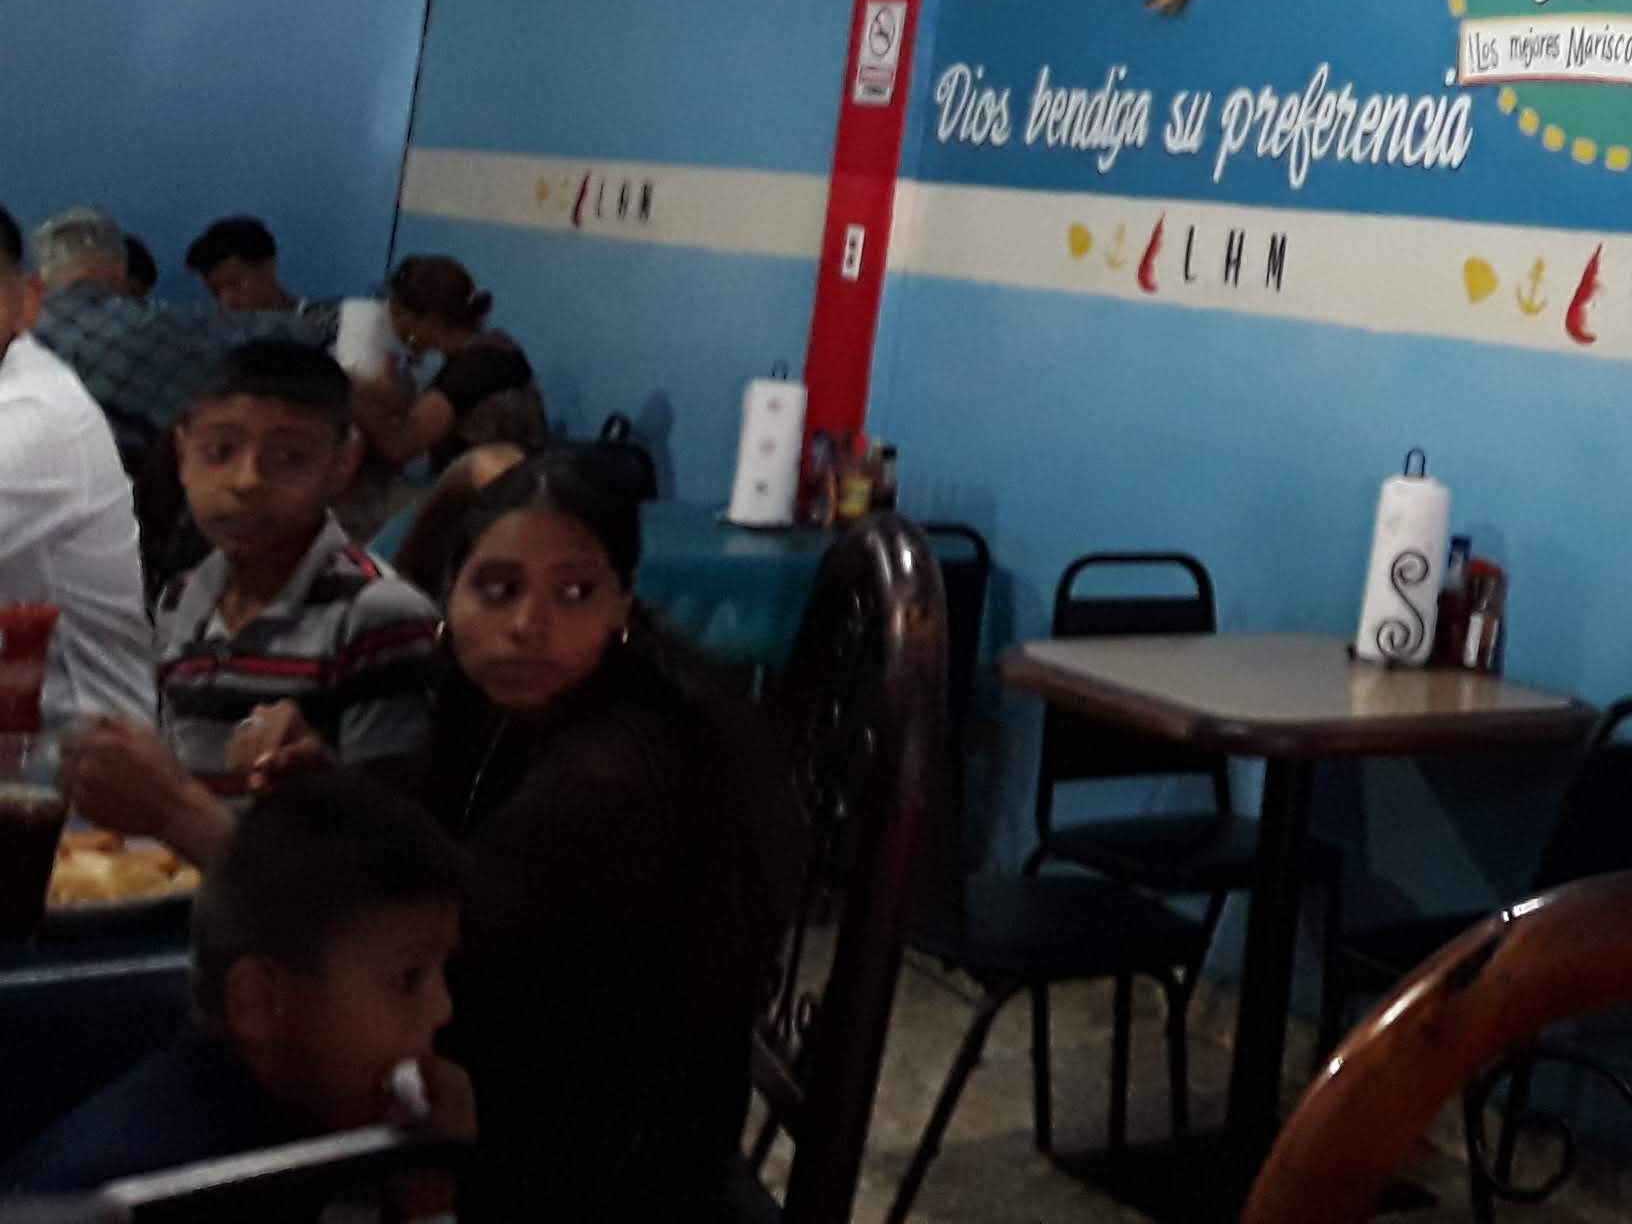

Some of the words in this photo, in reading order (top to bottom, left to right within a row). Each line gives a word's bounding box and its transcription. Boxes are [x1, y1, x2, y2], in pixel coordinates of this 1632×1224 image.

[1509, 26, 1561, 68] mejores
[935, 61, 1011, 145] Dios
[1024, 63, 1152, 175] bendiga
[1163, 90, 1212, 155] su
[1211, 60, 1475, 192] preferencia
